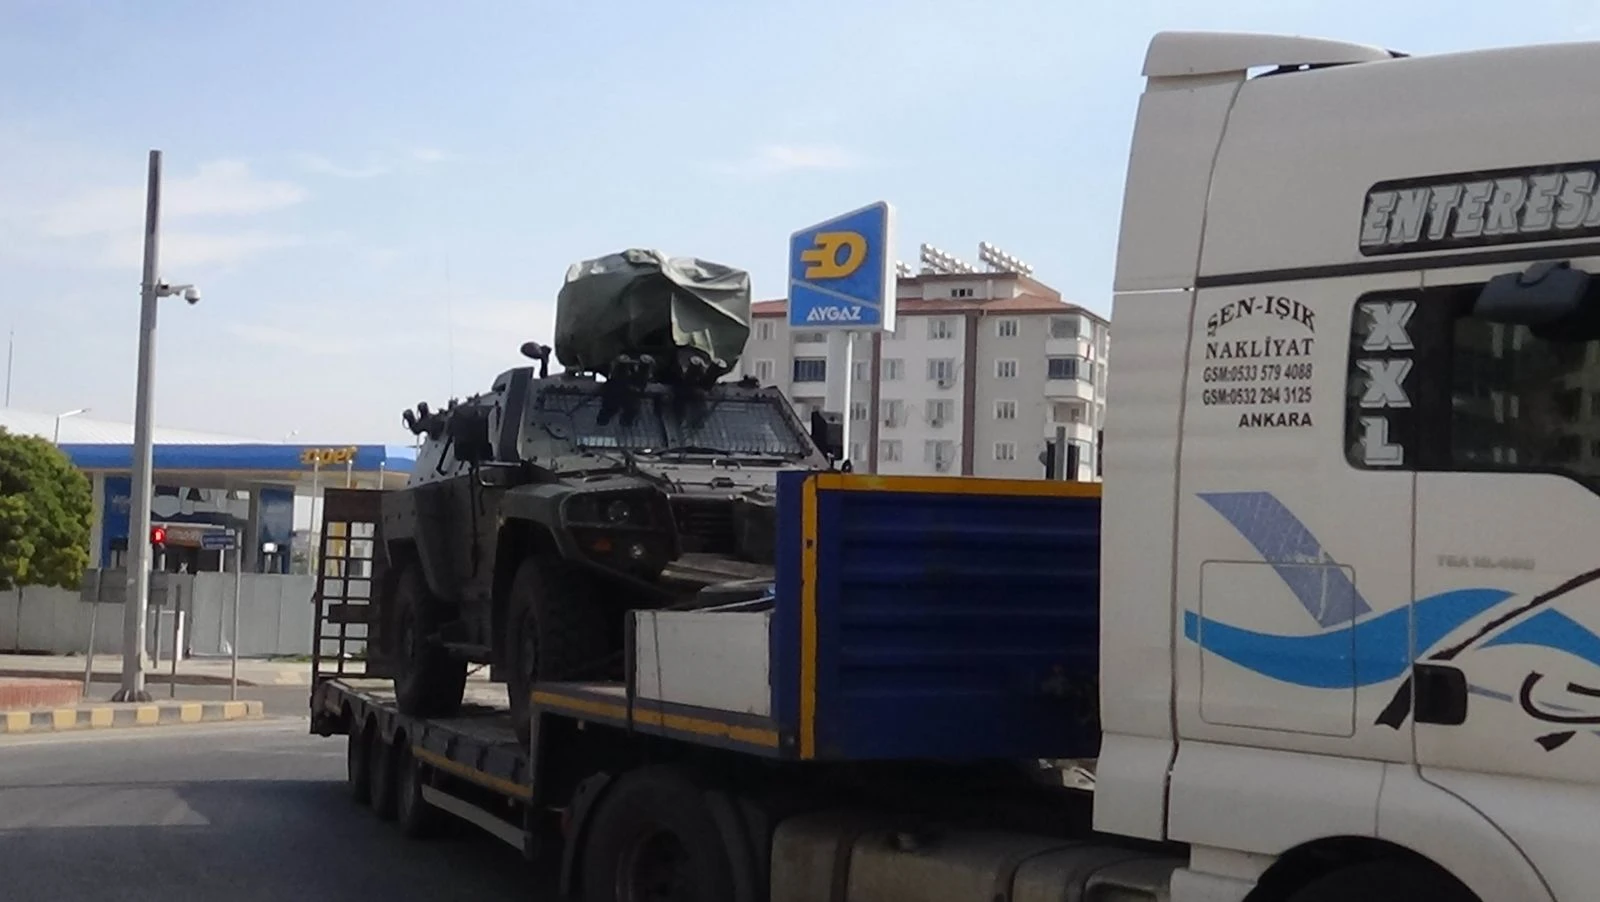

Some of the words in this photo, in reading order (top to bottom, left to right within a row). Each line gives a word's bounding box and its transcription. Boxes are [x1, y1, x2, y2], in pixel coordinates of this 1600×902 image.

[807, 306, 861, 322] AYGAZ
[1205, 336, 1314, 359] NAKLİYAT
[1261, 364, 1281, 380] 579
[1260, 386, 1280, 404] 294
[1284, 386, 1312, 403] 3125
[1239, 412, 1313, 428] ANKARA
